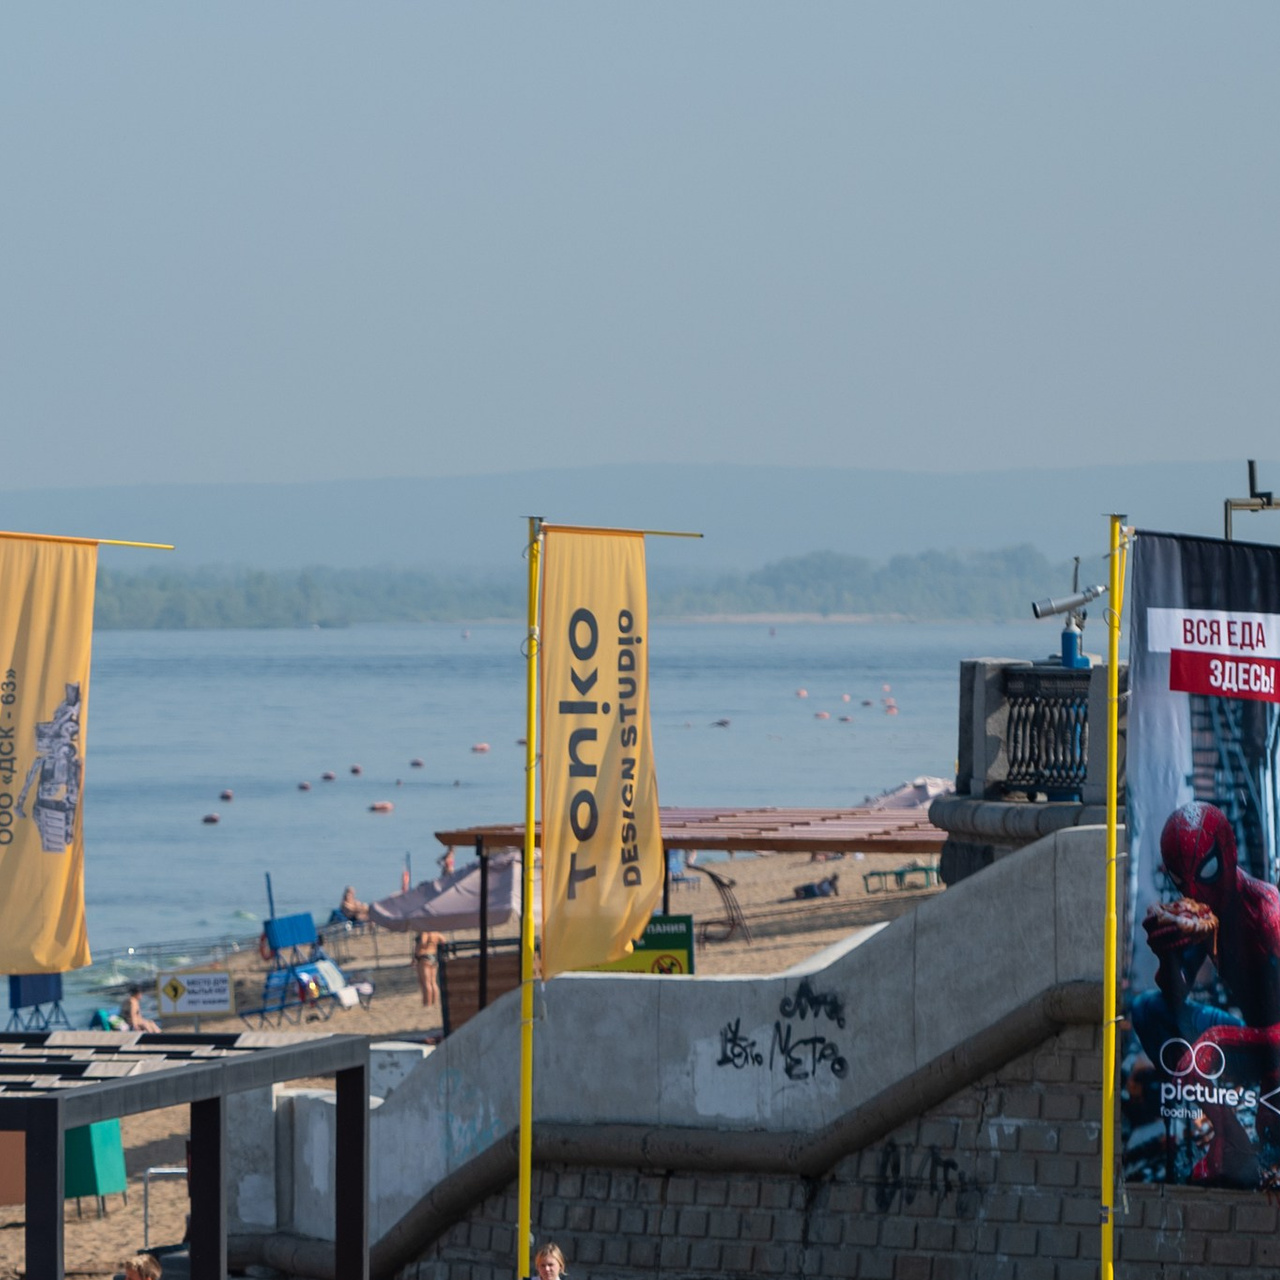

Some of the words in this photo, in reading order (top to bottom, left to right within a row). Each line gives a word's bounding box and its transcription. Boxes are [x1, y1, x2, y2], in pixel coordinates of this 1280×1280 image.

[1183, 618, 1221, 645] ВСЯ
[1227, 620, 1266, 650] ЕДА
[0, 668, 17, 705] 63»
[1209, 659, 1275, 694] ЗДЕСЬ!
[621, 758, 641, 887] DESIGN
[646, 922, 688, 935] ПАНИЯ
[1161, 1078, 1257, 1108] picture's
[1160, 1105, 1204, 1119] foodhall
